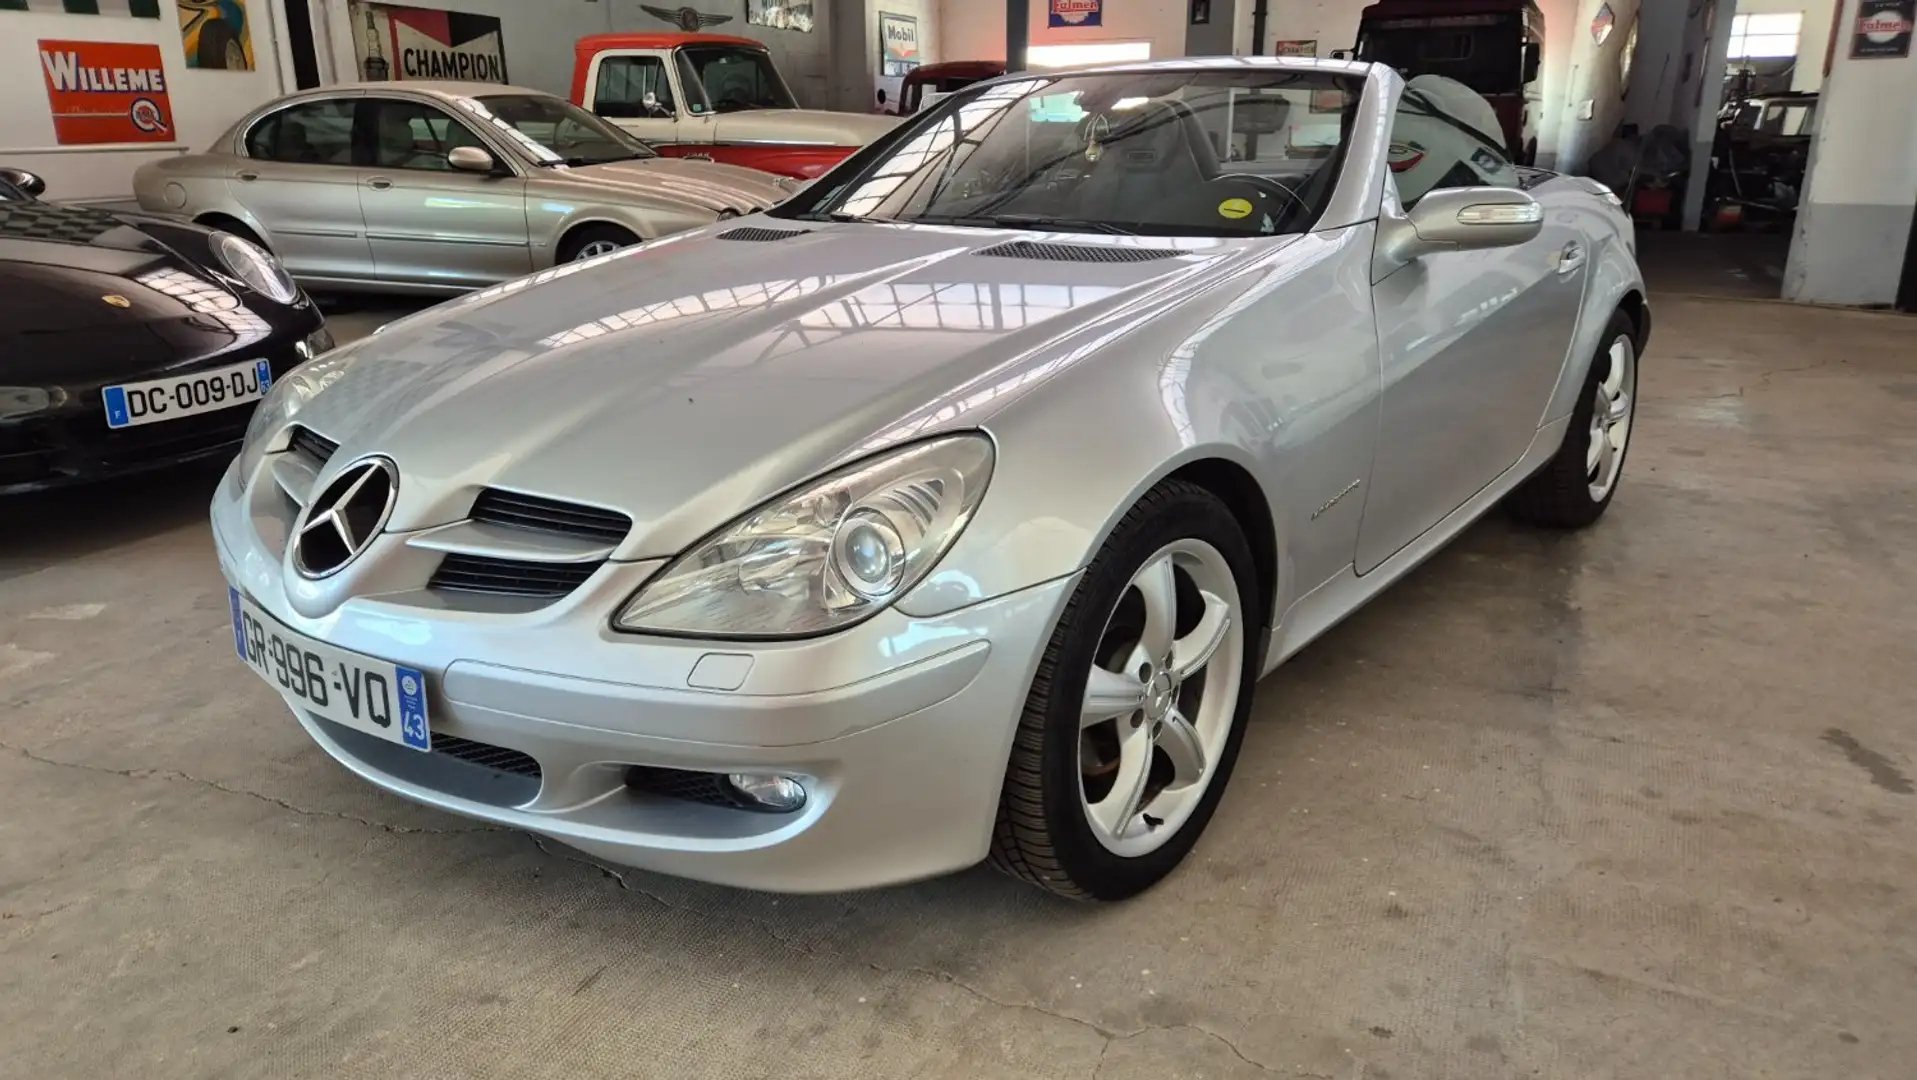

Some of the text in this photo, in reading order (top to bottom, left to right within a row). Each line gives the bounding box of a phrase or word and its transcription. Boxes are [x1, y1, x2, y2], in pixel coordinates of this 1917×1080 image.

[888, 25, 914, 42] Mobil
[40, 50, 164, 92] WILLEME
[403, 48, 500, 81] CHAMPION
[127, 368, 258, 418] DC-009-DJ
[402, 711, 425, 741] 43
